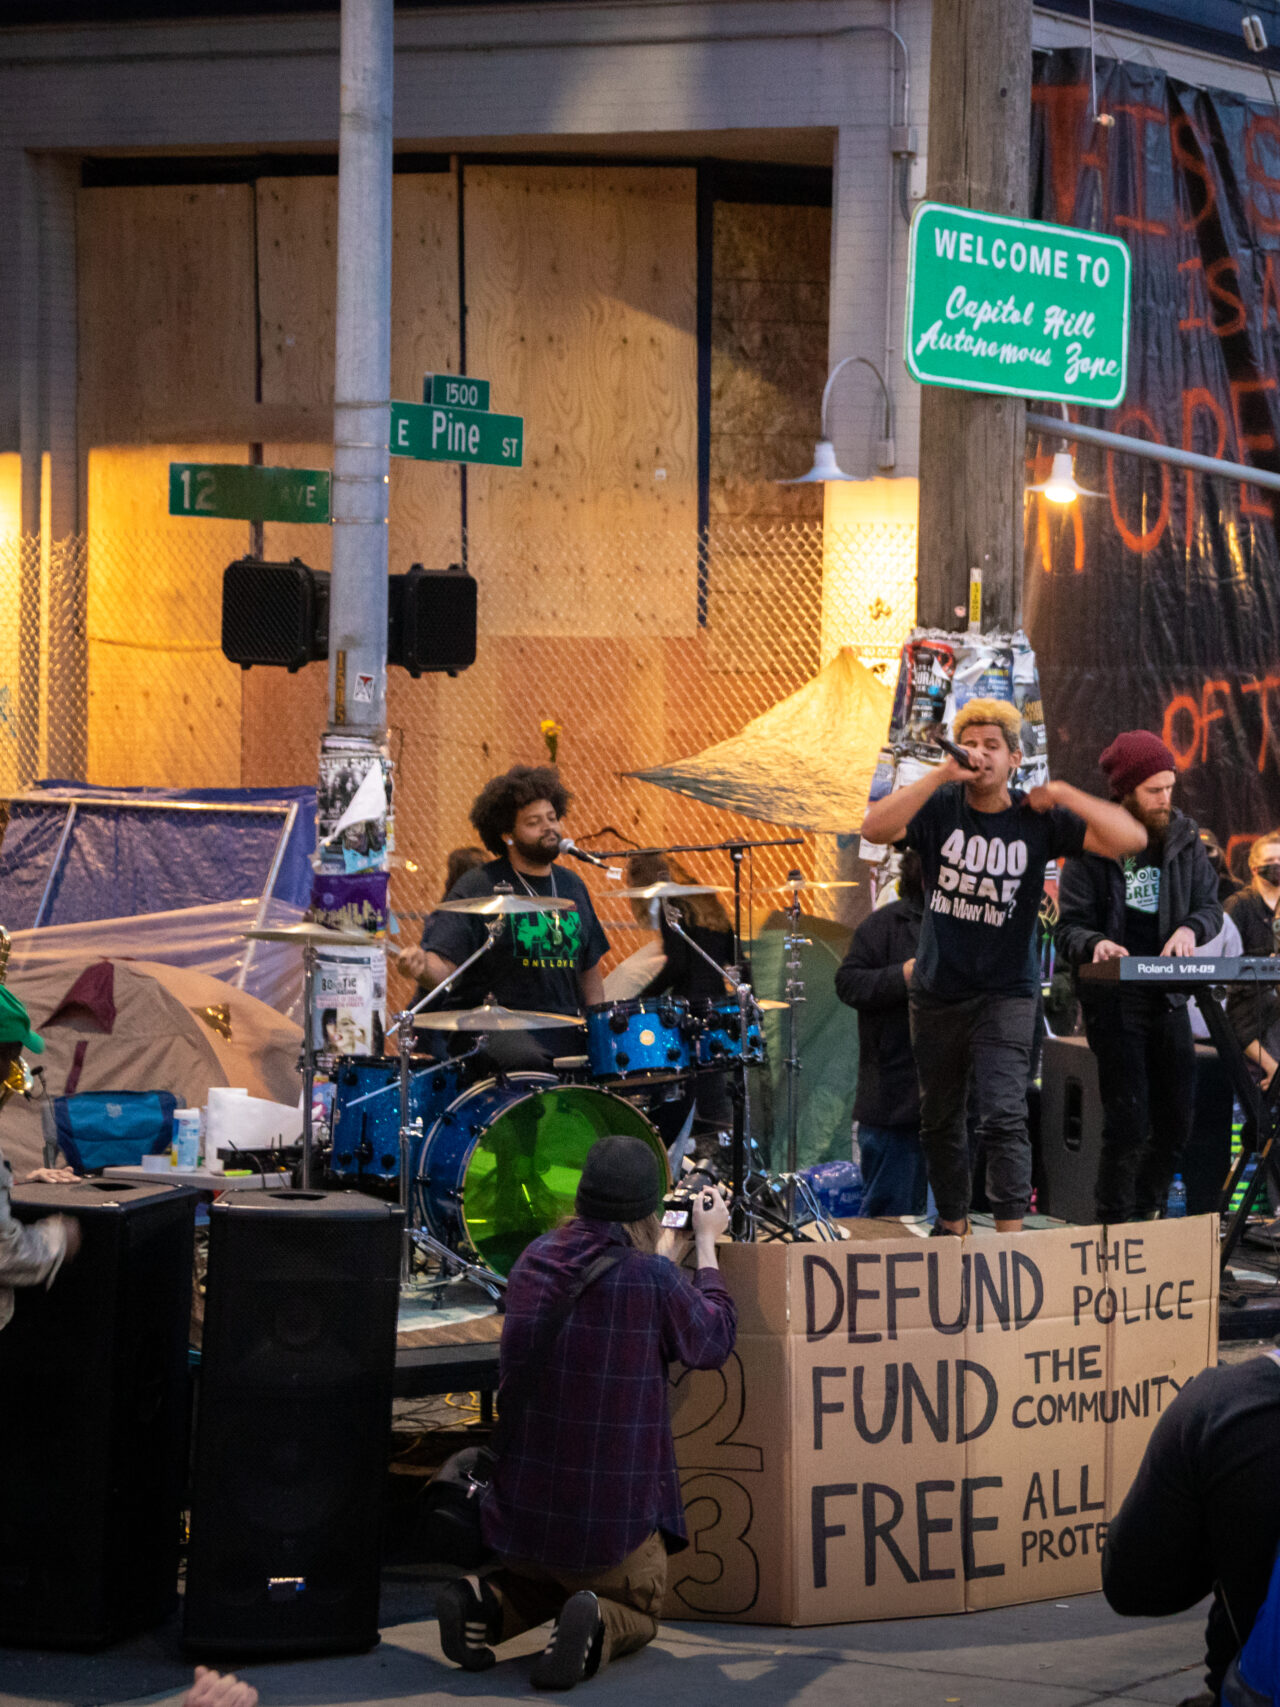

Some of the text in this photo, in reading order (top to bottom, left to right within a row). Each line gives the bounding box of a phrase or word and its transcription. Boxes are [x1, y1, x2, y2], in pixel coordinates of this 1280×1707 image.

[934, 227, 1110, 288] WELCOME TO
[946, 286, 1096, 340] Capitol Hill
[1178, 257, 1246, 336] IS
[916, 320, 1120, 384] Autonomous Zone
[445, 382, 479, 406] 1500
[398, 411, 519, 459] E Pine ST
[180, 470, 217, 511] 12
[1161, 680, 1231, 772] OF
[940, 828, 1028, 877] 4,000
[937, 864, 1022, 904] DEAD
[522, 959, 575, 968] ONE LOVE
[1137, 962, 1216, 974] Roland VR-09
[802, 1239, 1148, 1345] DEFUND THE
[1073, 1280, 1195, 1326] POLICE
[812, 1344, 1103, 1451] FUND THE
[674, 1473, 760, 1615] 3
[811, 1464, 1105, 1589] FREE ALL
[1020, 1521, 1110, 1567] PROTE
